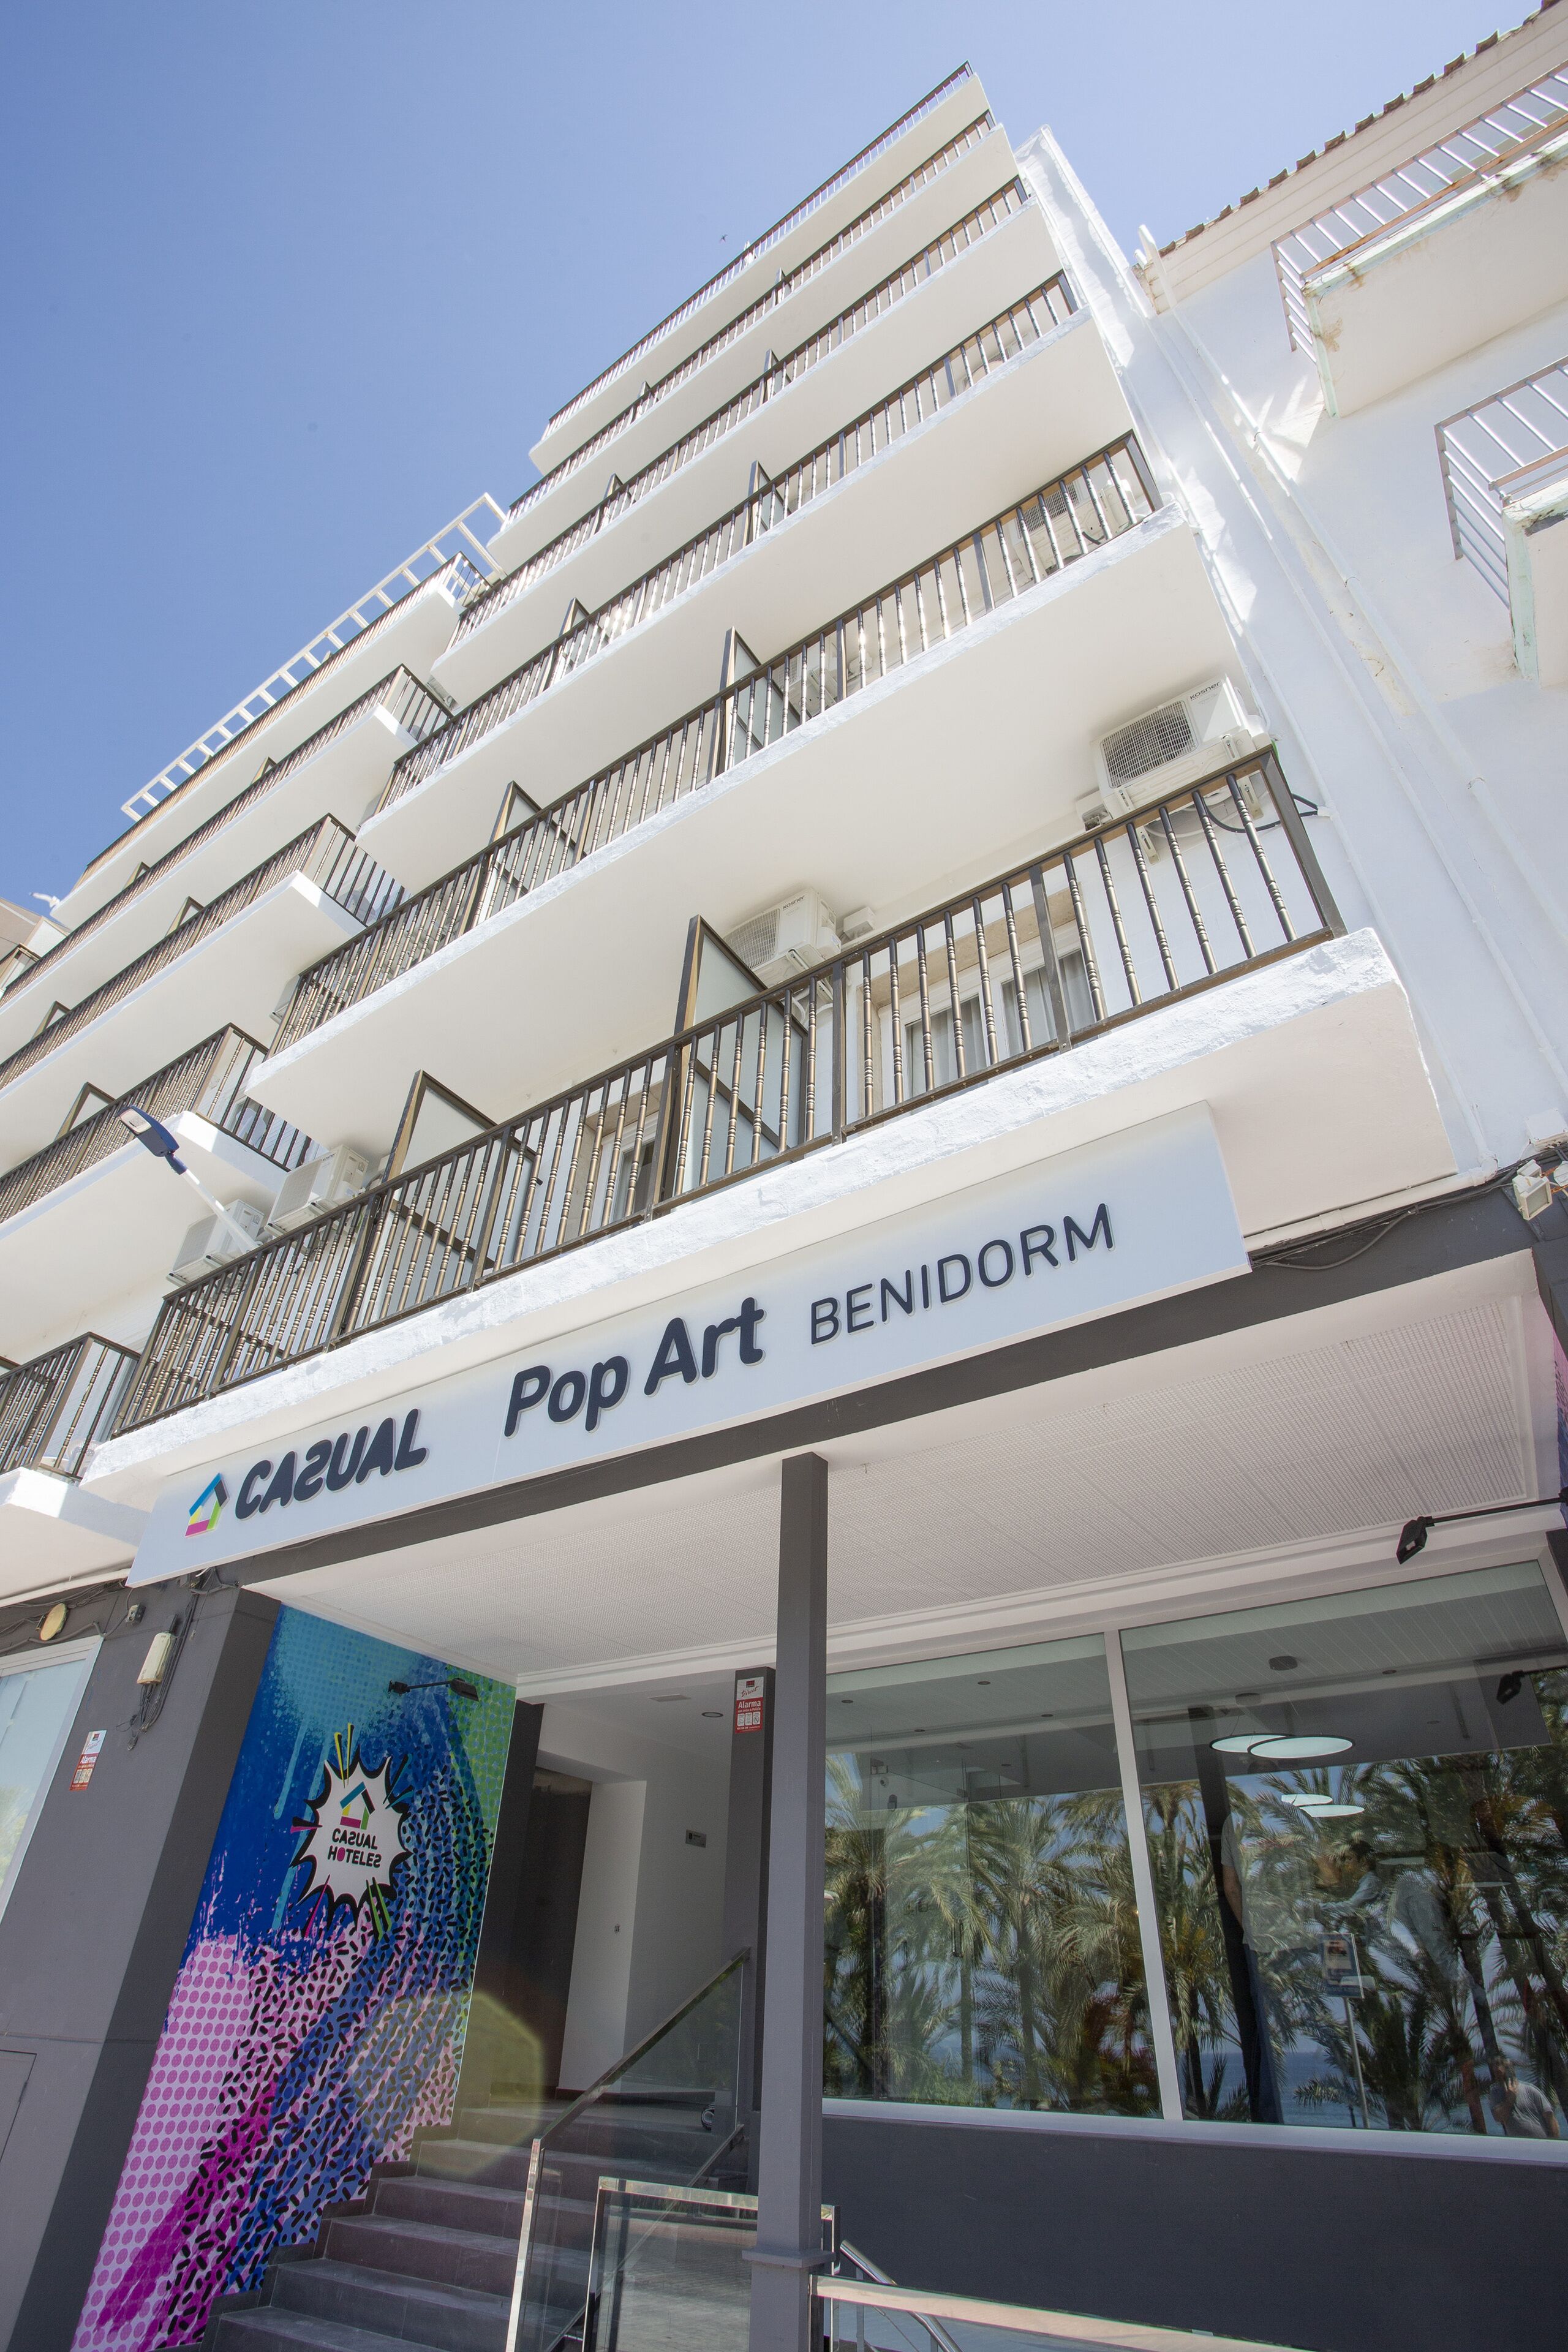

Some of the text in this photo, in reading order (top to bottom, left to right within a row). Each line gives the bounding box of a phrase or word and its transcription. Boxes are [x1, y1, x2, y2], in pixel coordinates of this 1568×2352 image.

[235, 1202, 1115, 1520] CASUAL Pop Art BENIDORM
[738, 1700, 761, 1709] Alarma
[332, 1828, 379, 1850] CASUAL
[327, 1845, 382, 1868] HOTELES
